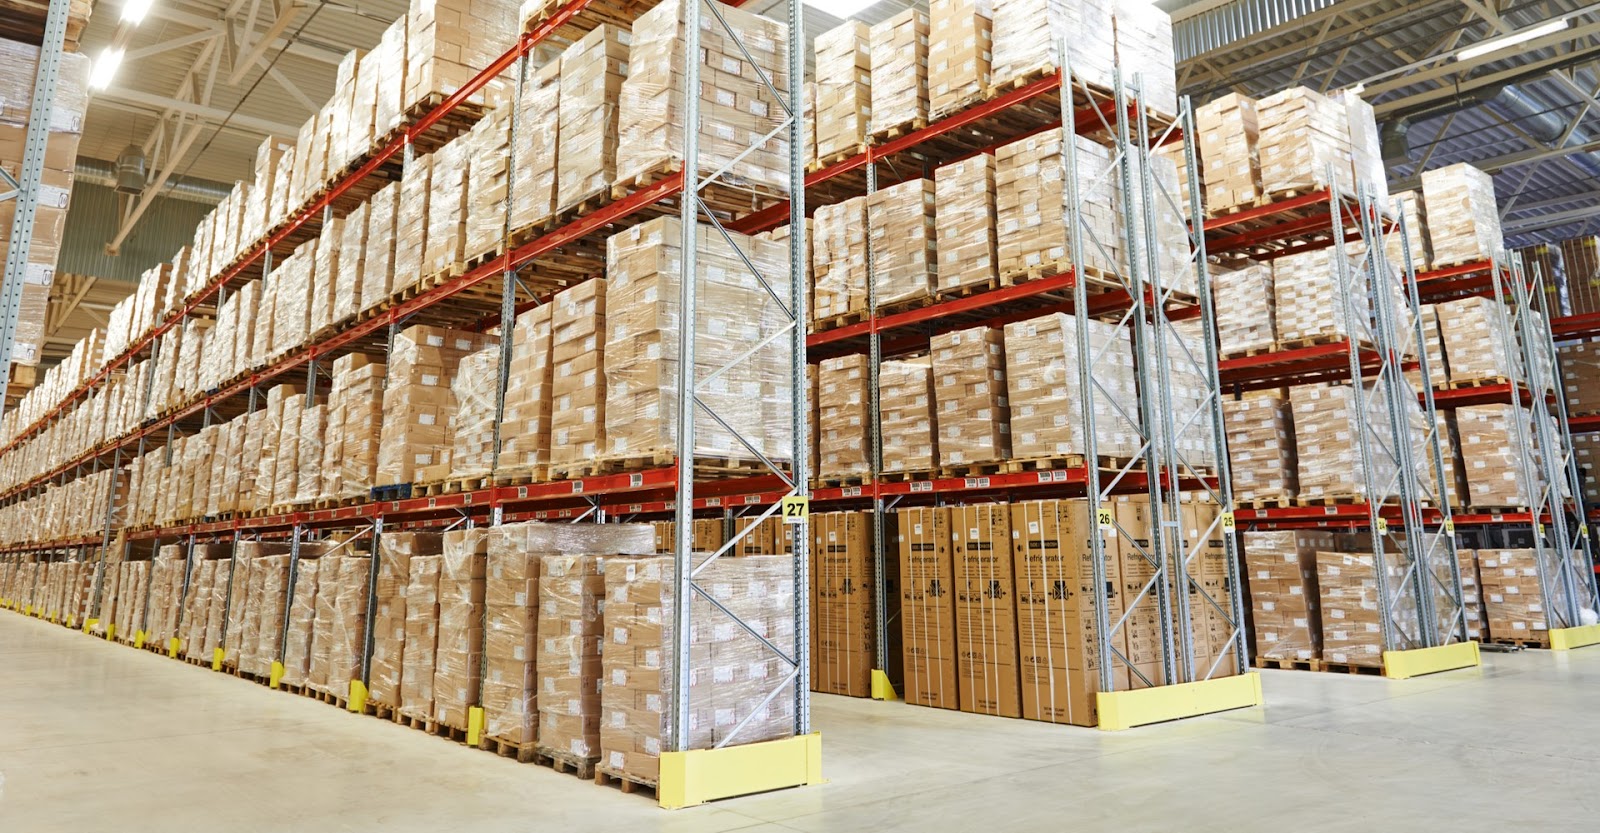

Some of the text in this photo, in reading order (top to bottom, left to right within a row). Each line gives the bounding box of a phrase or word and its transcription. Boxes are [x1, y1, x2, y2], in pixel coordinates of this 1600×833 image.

[787, 503, 805, 517] 27
[1099, 513, 1110, 525] 26
[1224, 517, 1234, 527] 25
